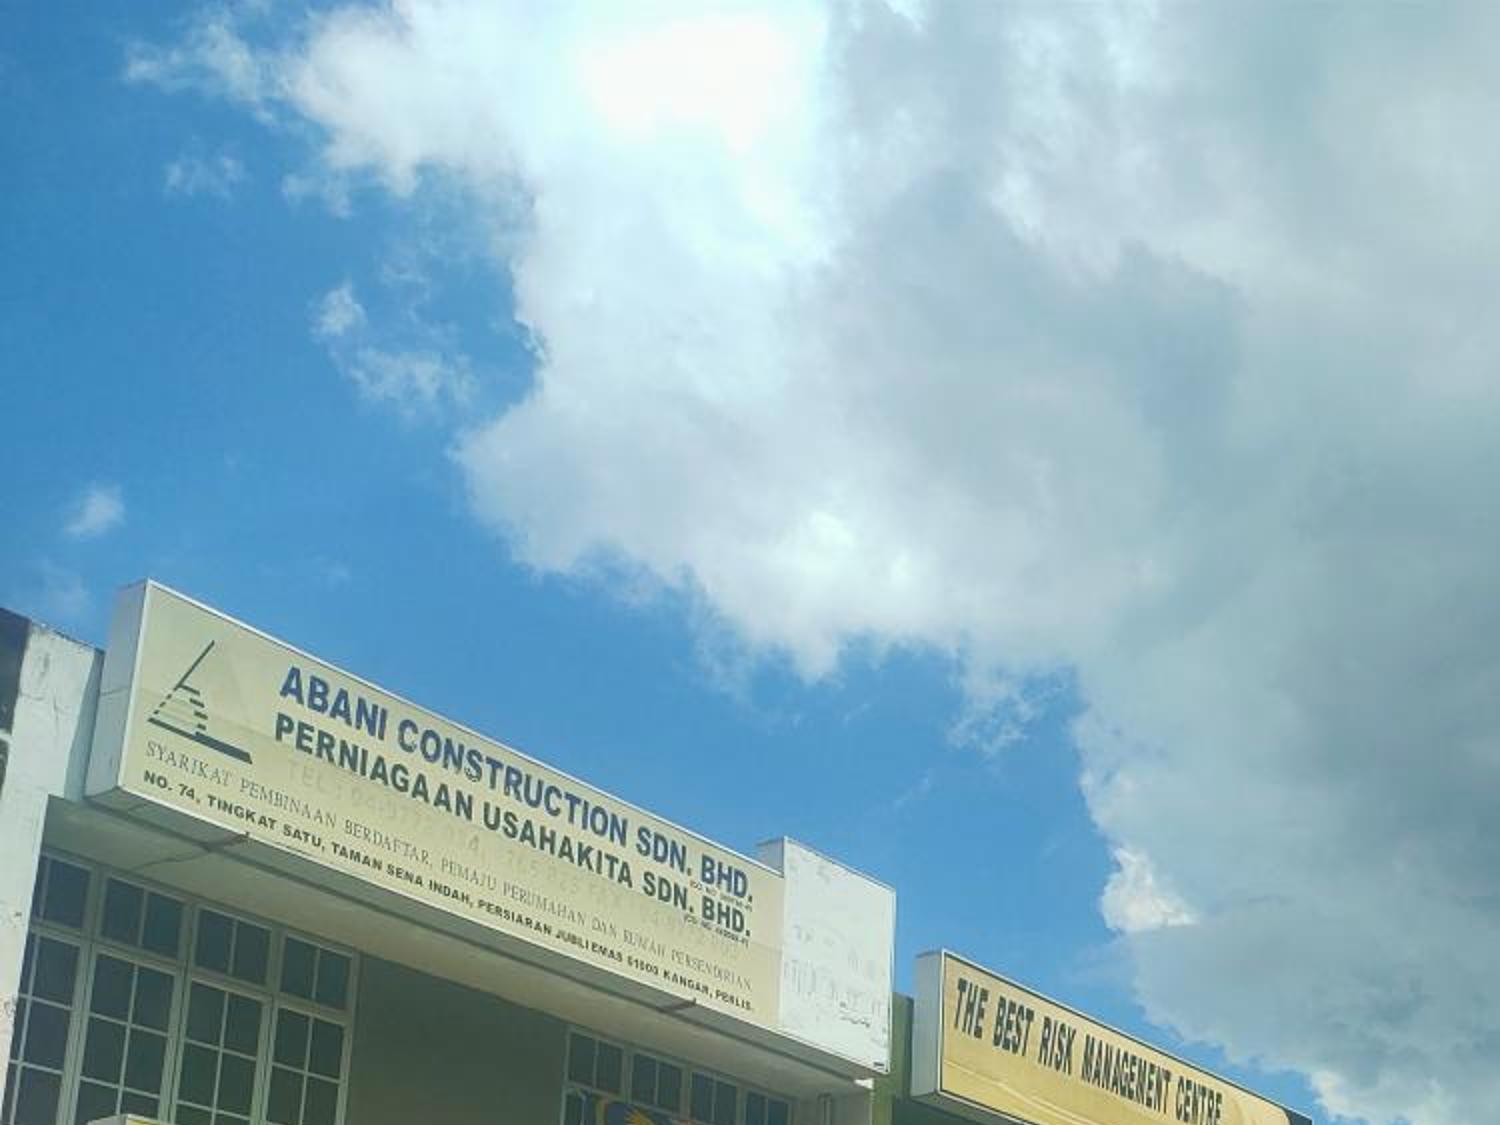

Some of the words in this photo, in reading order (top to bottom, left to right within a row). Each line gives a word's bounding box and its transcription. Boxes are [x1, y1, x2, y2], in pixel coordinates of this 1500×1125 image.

[144, 769, 174, 792] NO.
[178, 783, 200, 804] 74,
[207, 796, 278, 832] TINGKAT
[283, 823, 326, 854] SATU,
[331, 842, 384, 871] TAMAN
[387, 864, 423, 889] SENA
[429, 879, 474, 908] INDAH,
[478, 898, 552, 938] PERSIARAN
[591, 942, 623, 963] EMAS
[146, 740, 232, 788] SYARIKAT
[240, 776, 338, 830] PEMBINAAN
[441, 856, 498, 892] PEMAJU
[503, 879, 586, 926] PERUMAHAN
[592, 916, 618, 940] DAN
[275, 713, 473, 821] PERNIAGAAN
[483, 801, 634, 888] USAHAKITA
[643, 871, 694, 914] SDN.
[701, 895, 751, 937] BHD.
[279, 666, 387, 741] ABANI
[397, 718, 628, 847] CONSTRUCTION
[636, 826, 692, 876] SDN.
[701, 854, 753, 903] BHD.
[954, 978, 989, 1040] THE
[992, 995, 1035, 1060] BEST
[1037, 1015, 1078, 1077] RISK
[1081, 1034, 1172, 1115] MANAGEMENT
